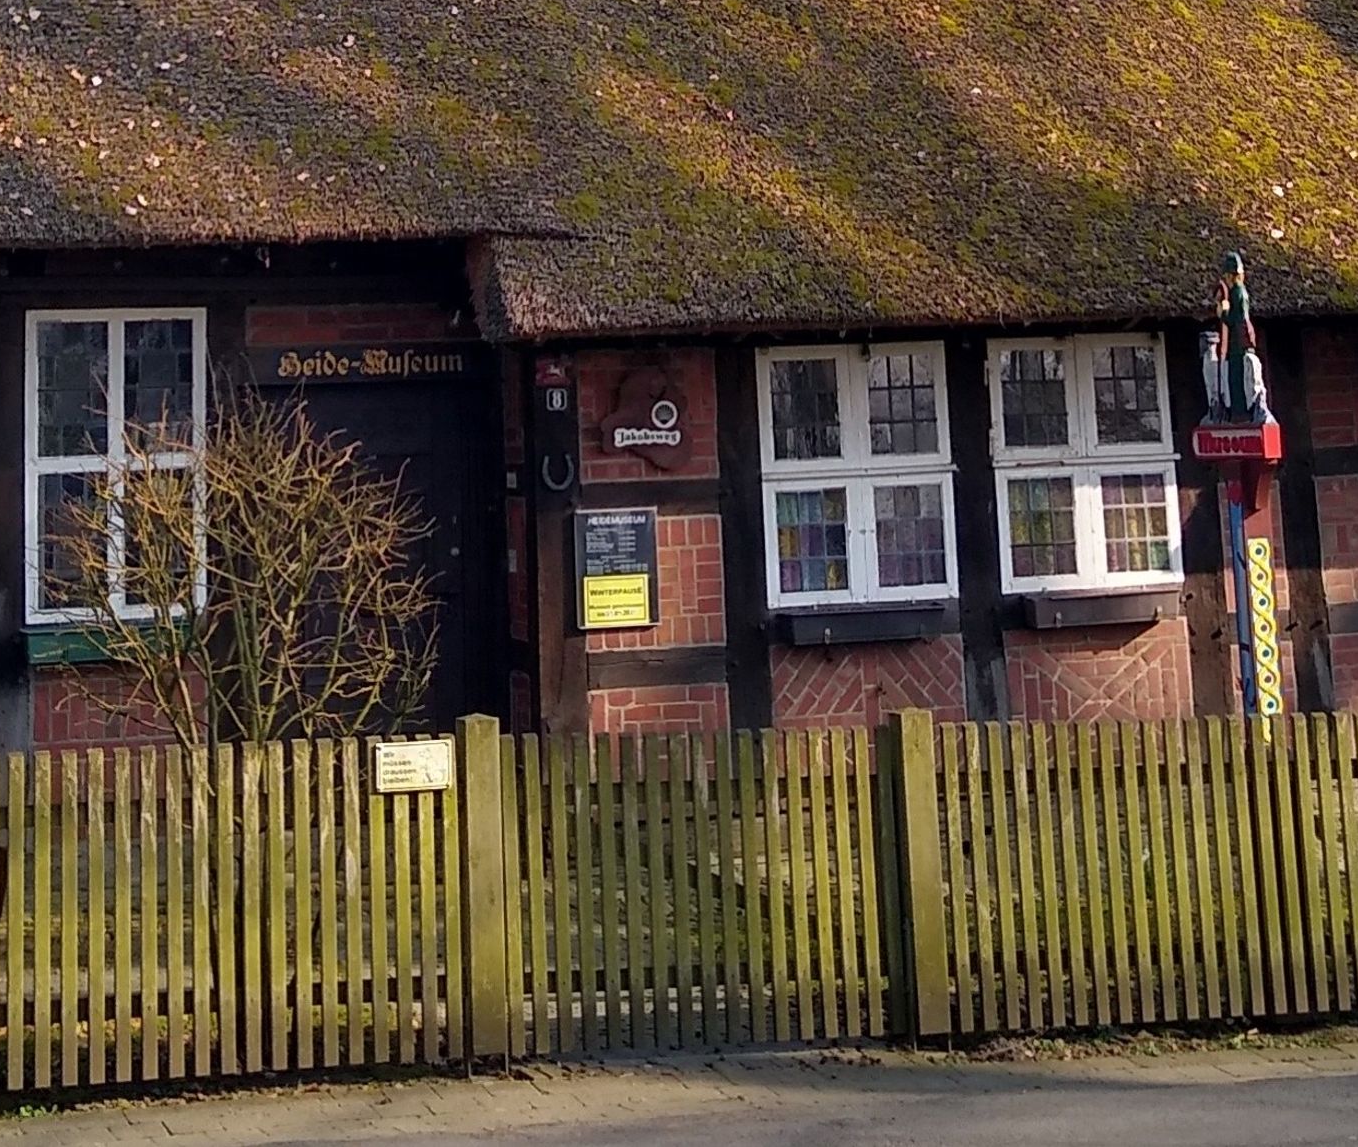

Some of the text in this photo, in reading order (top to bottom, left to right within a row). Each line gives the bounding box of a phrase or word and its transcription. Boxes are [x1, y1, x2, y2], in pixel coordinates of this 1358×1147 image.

[552, 391, 562, 409] 8
[617, 431, 678, 444] Jakobsweg
[1197, 433, 1262, 454] Museum
